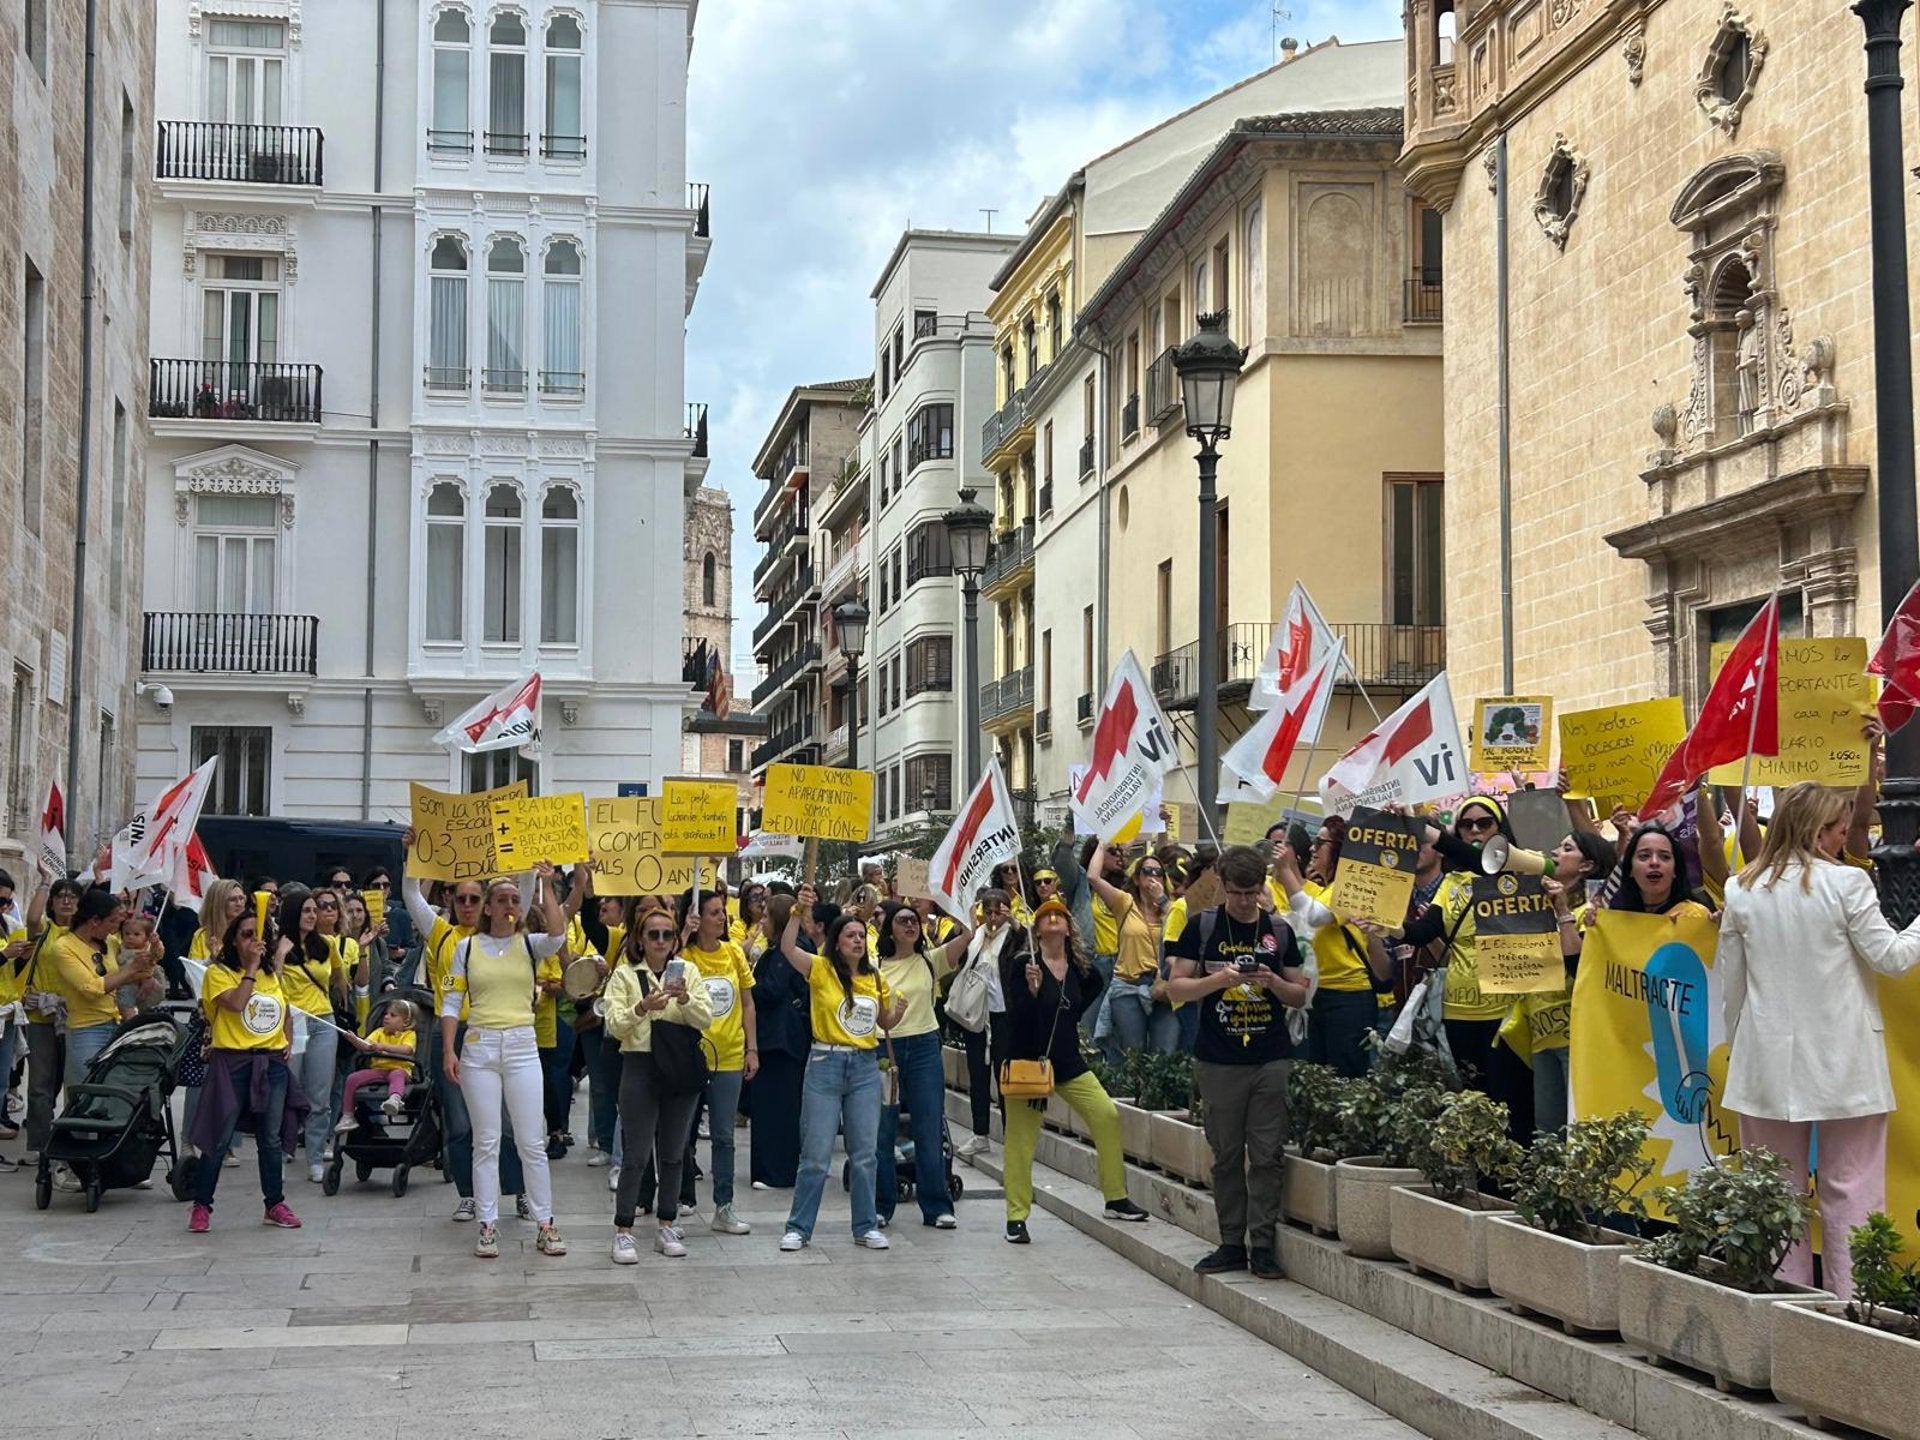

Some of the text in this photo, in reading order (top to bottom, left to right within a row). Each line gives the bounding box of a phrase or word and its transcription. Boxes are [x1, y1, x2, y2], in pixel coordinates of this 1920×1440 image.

[597, 803, 620, 824] EL
[775, 814, 851, 838] EDUCACIÓN
[1348, 826, 1418, 851] OFERTA
[595, 858, 624, 876] ALS
[1477, 895, 1554, 917] OFERTA
[1604, 960, 1695, 1016] MALTRACTE
